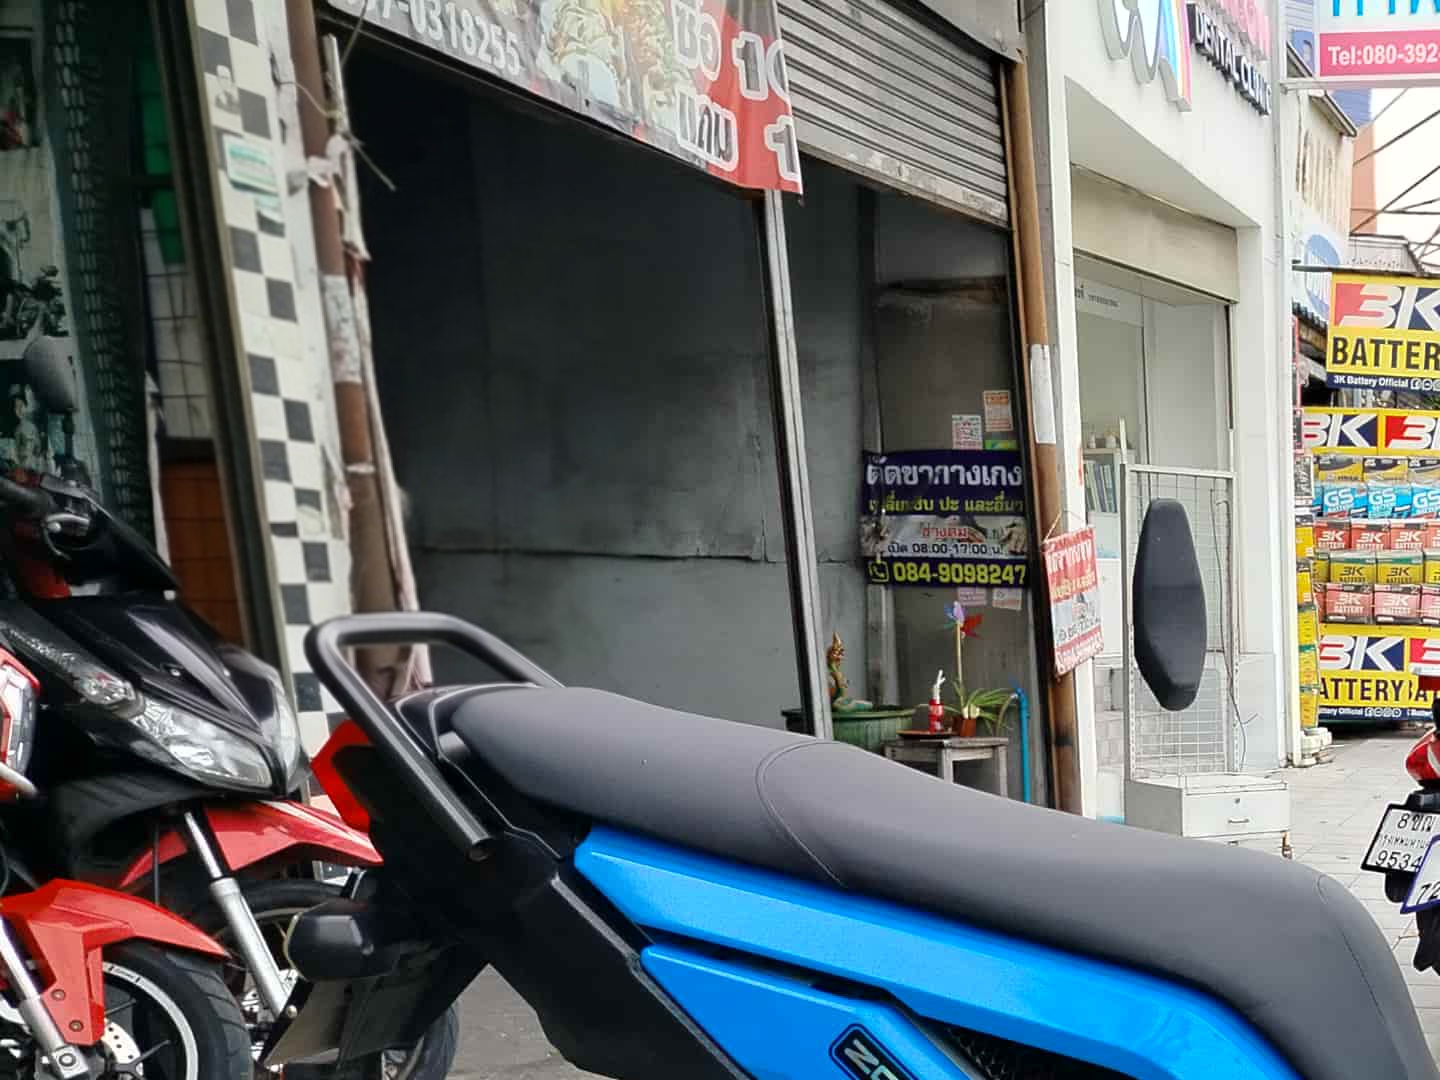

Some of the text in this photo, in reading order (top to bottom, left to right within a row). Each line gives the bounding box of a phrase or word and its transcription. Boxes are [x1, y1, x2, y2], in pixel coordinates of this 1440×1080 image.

[1193, 3, 1240, 84] DENTAL
[1333, 374, 1409, 388] 3K Battery Official
[1323, 488, 1354, 507] GS
[1368, 488, 1397, 505] GS
[1319, 532, 1344, 542] 3K
[1357, 533, 1385, 543] 3K
[1395, 531, 1422, 542] 3K
[892, 563, 1026, 585] 084-9098247
[1339, 566, 1364, 576] 3K
[1386, 567, 1410, 577] 3K
[1319, 677, 1402, 701] ATTERY
[1375, 850, 1422, 871] 9534
